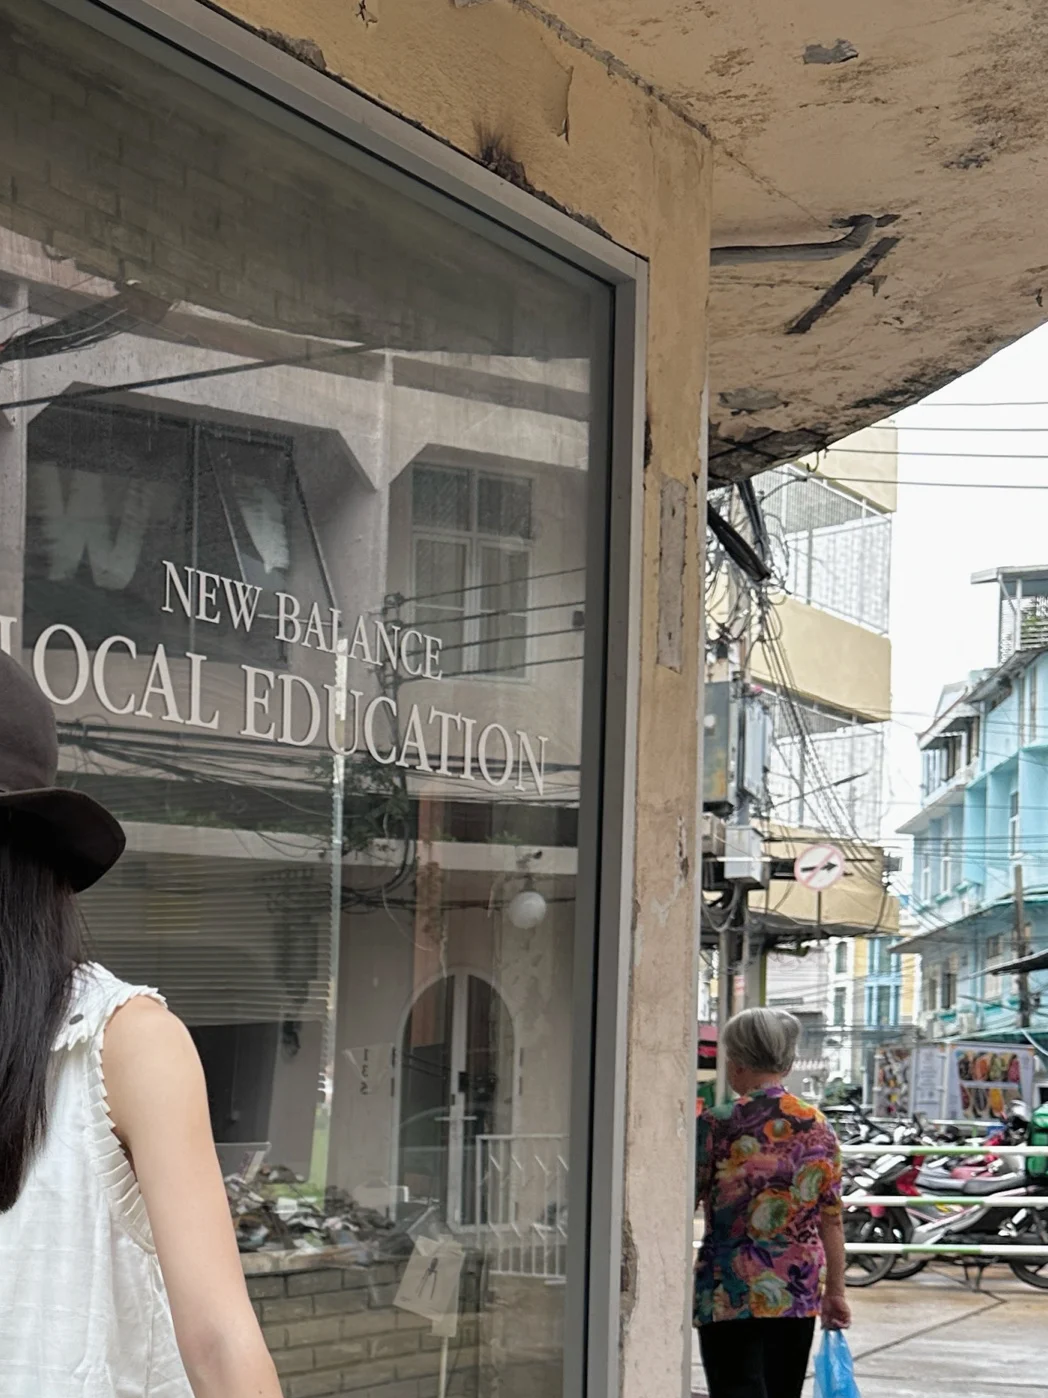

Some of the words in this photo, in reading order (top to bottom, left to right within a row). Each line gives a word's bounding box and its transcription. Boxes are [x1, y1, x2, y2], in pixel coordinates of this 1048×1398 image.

[161, 560, 263, 633] NEW
[274, 591, 443, 681] BALANCE
[239, 664, 550, 797] EDUCATION
